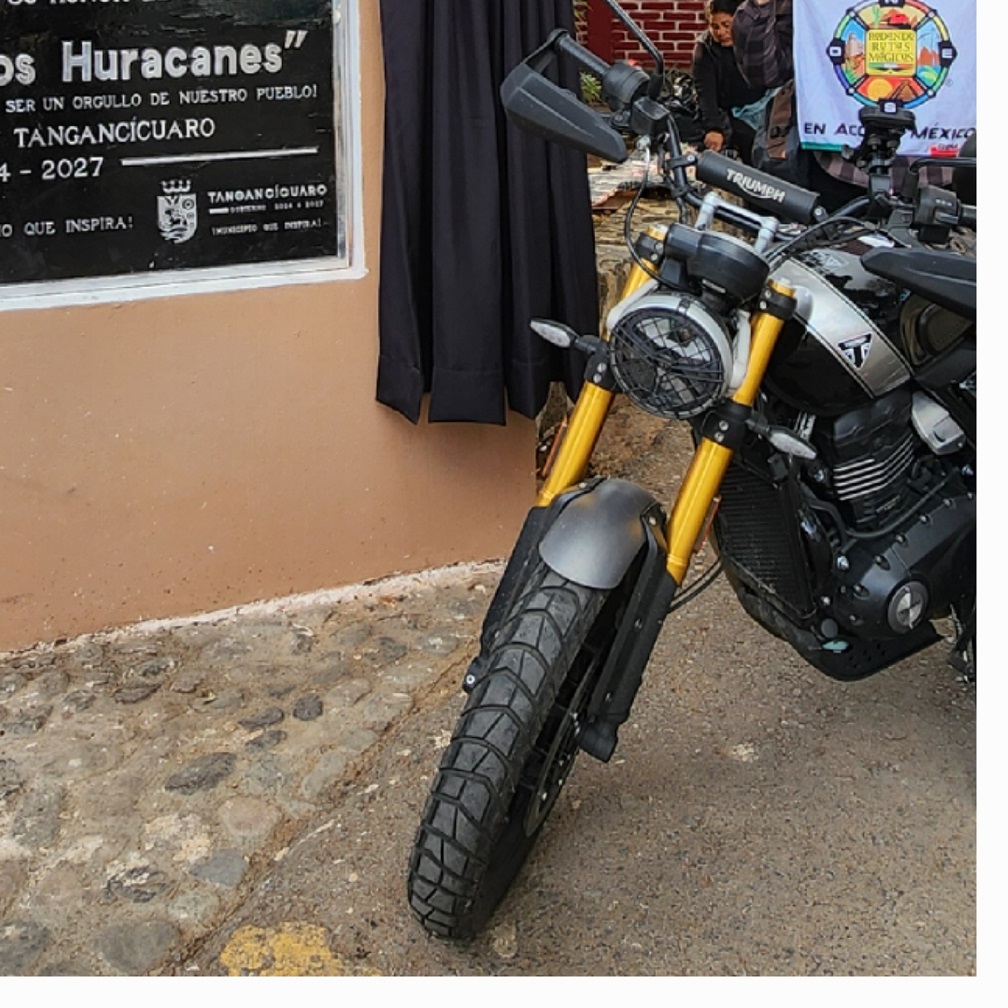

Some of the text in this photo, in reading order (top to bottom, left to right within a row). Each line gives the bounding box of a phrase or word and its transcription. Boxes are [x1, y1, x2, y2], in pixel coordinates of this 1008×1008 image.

[60, 29, 309, 84] Huracanes"
[4, 98, 37, 115] SER
[42, 95, 66, 112] UN
[71, 92, 143, 112] ORGULLO
[149, 90, 171, 107] DE
[178, 88, 249, 106] NUESTRO
[255, 84, 319, 102] PUEBLO!
[12, 116, 217, 150] TANGANCÍCUARO
[804, 122, 827, 135] EN
[40, 156, 105, 181] 2027
[726, 169, 786, 204] TRIUMPH
[23, 219, 56, 236] QUE
[65, 215, 135, 234] INSPIRA!
